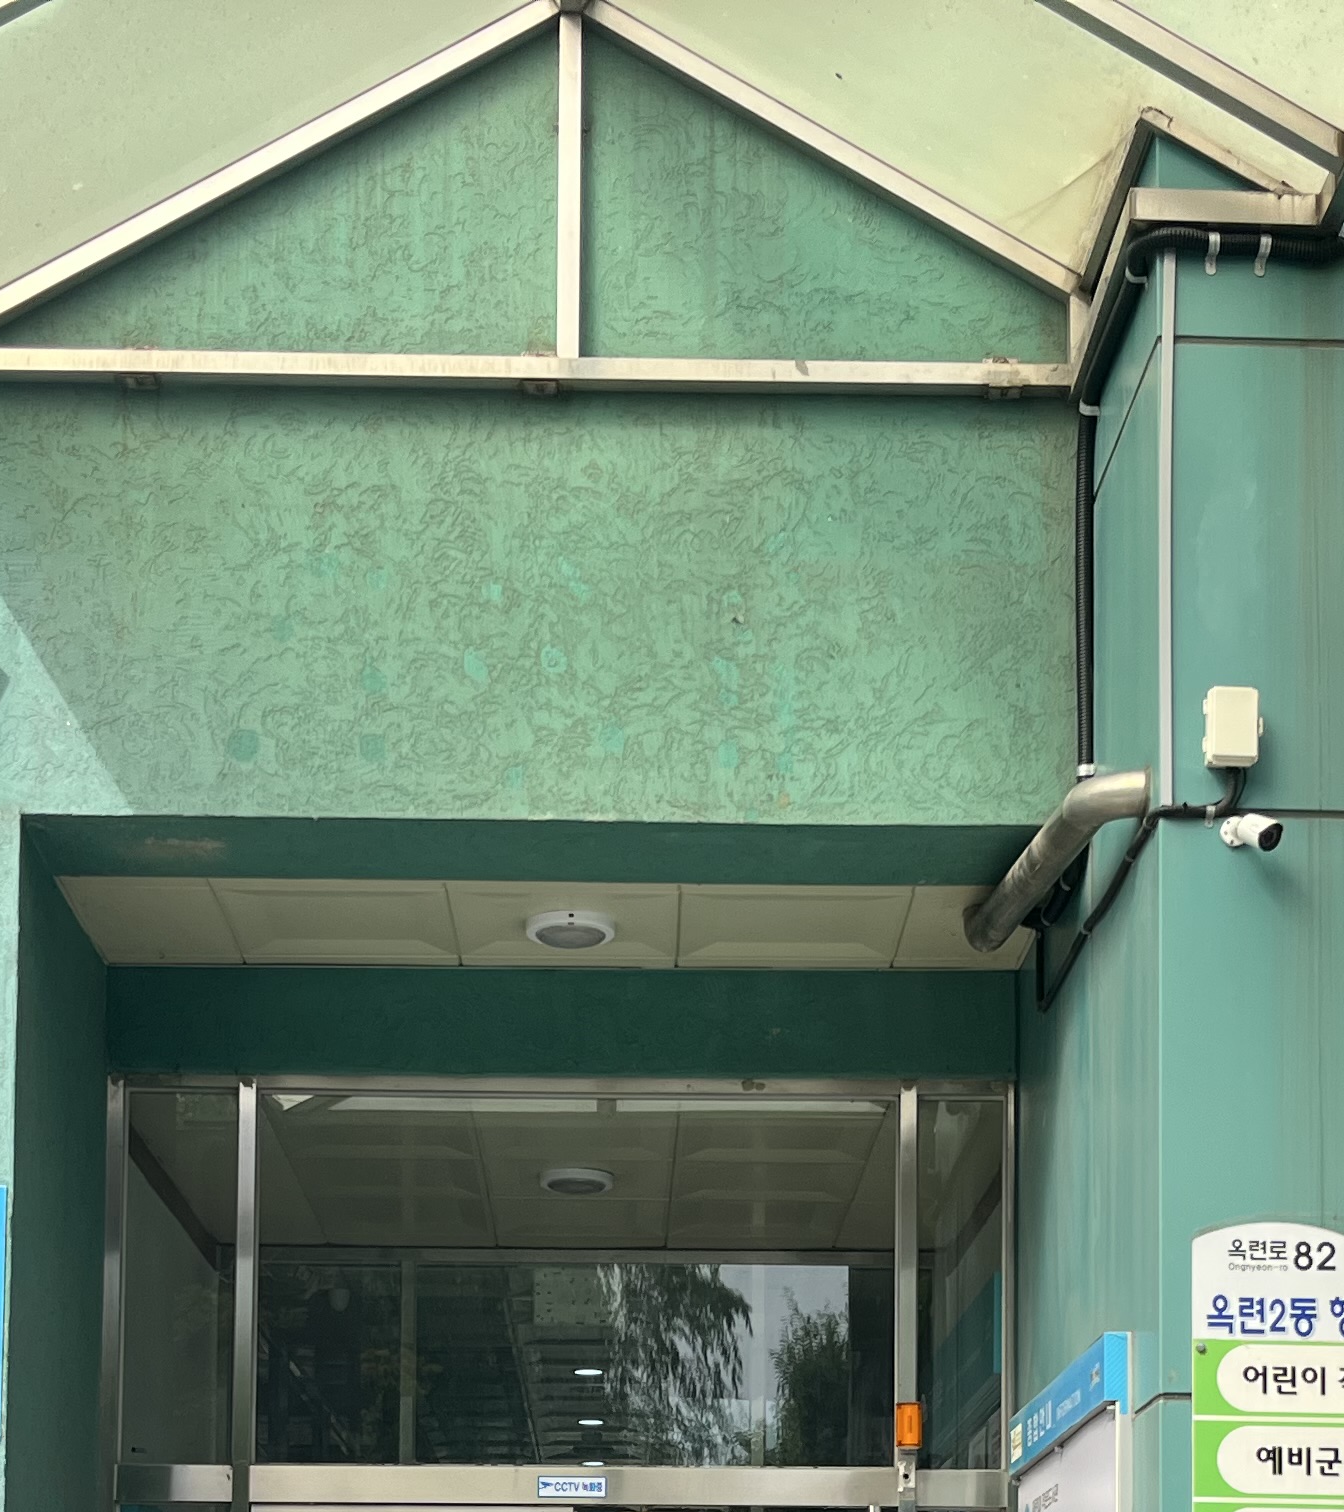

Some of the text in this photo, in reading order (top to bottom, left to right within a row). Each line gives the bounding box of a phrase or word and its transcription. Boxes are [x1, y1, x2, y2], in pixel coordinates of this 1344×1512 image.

[1227, 1239, 1336, 1271] 옥련로 82
[1228, 1262, 1288, 1272] Ongnyeon-ro
[1206, 1294, 1319, 1338] 옥련2동
[1242, 1365, 1326, 1396] 어린이
[1256, 1446, 1343, 1476] 예비군
[554, 1482, 580, 1492] CCTV
